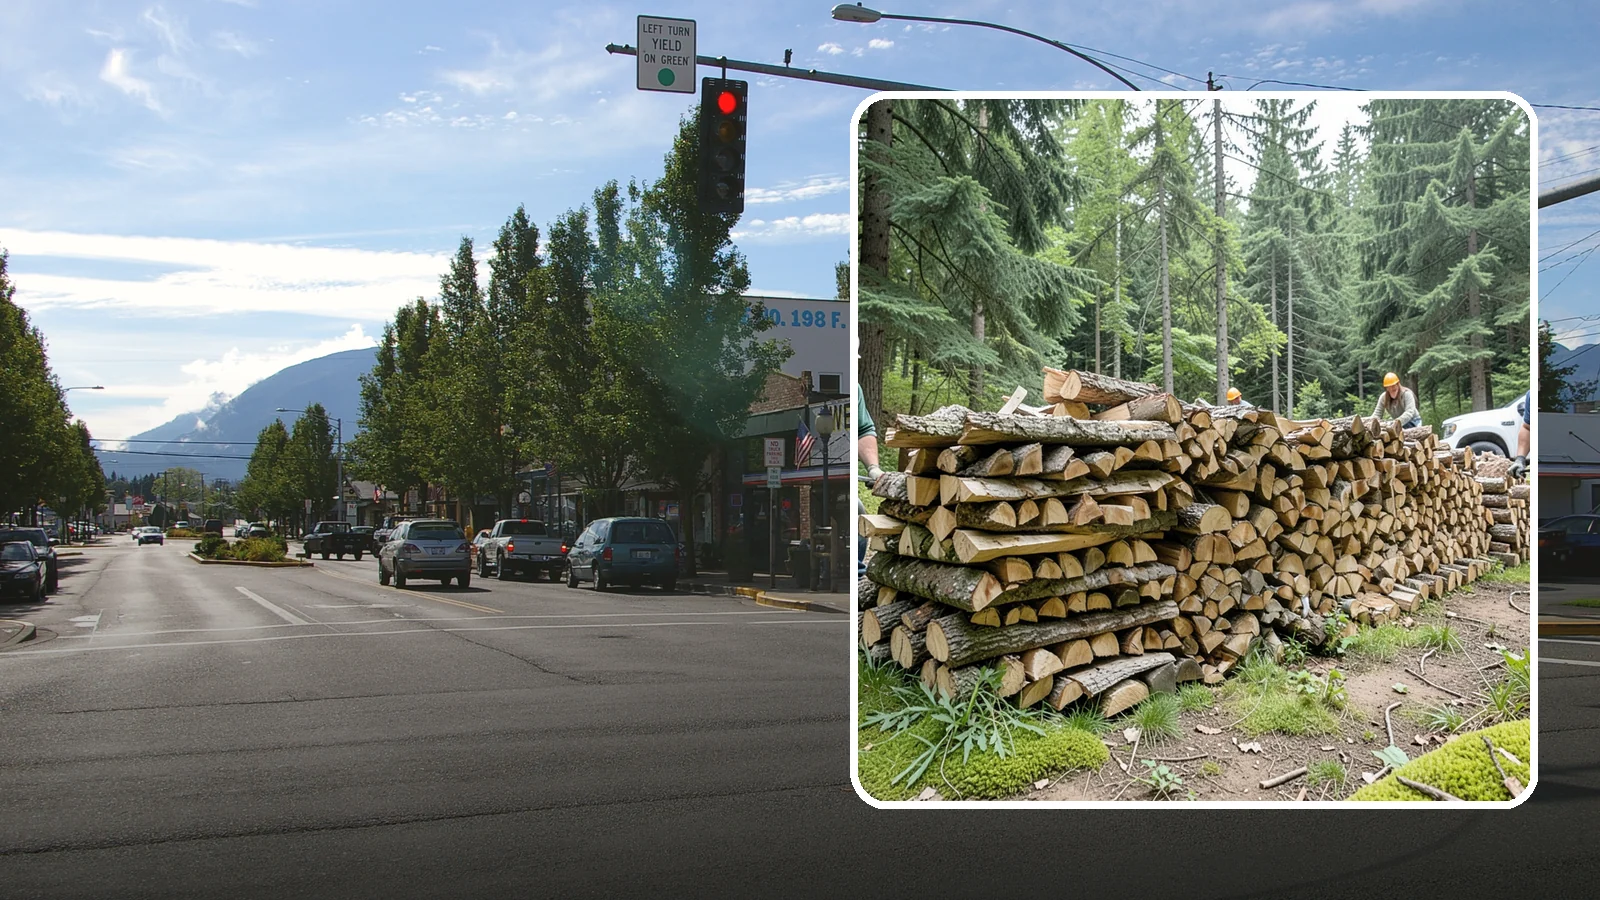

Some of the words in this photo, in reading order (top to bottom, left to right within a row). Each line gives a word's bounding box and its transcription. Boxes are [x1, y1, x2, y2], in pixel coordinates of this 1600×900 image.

[642, 23, 663, 34] LEFT
[668, 25, 690, 37] TURN
[652, 38, 682, 52] YIELD
[644, 53, 656, 64] ON
[661, 55, 689, 66] GREEN
[791, 309, 826, 328] 198
[831, 311, 847, 329] F.
